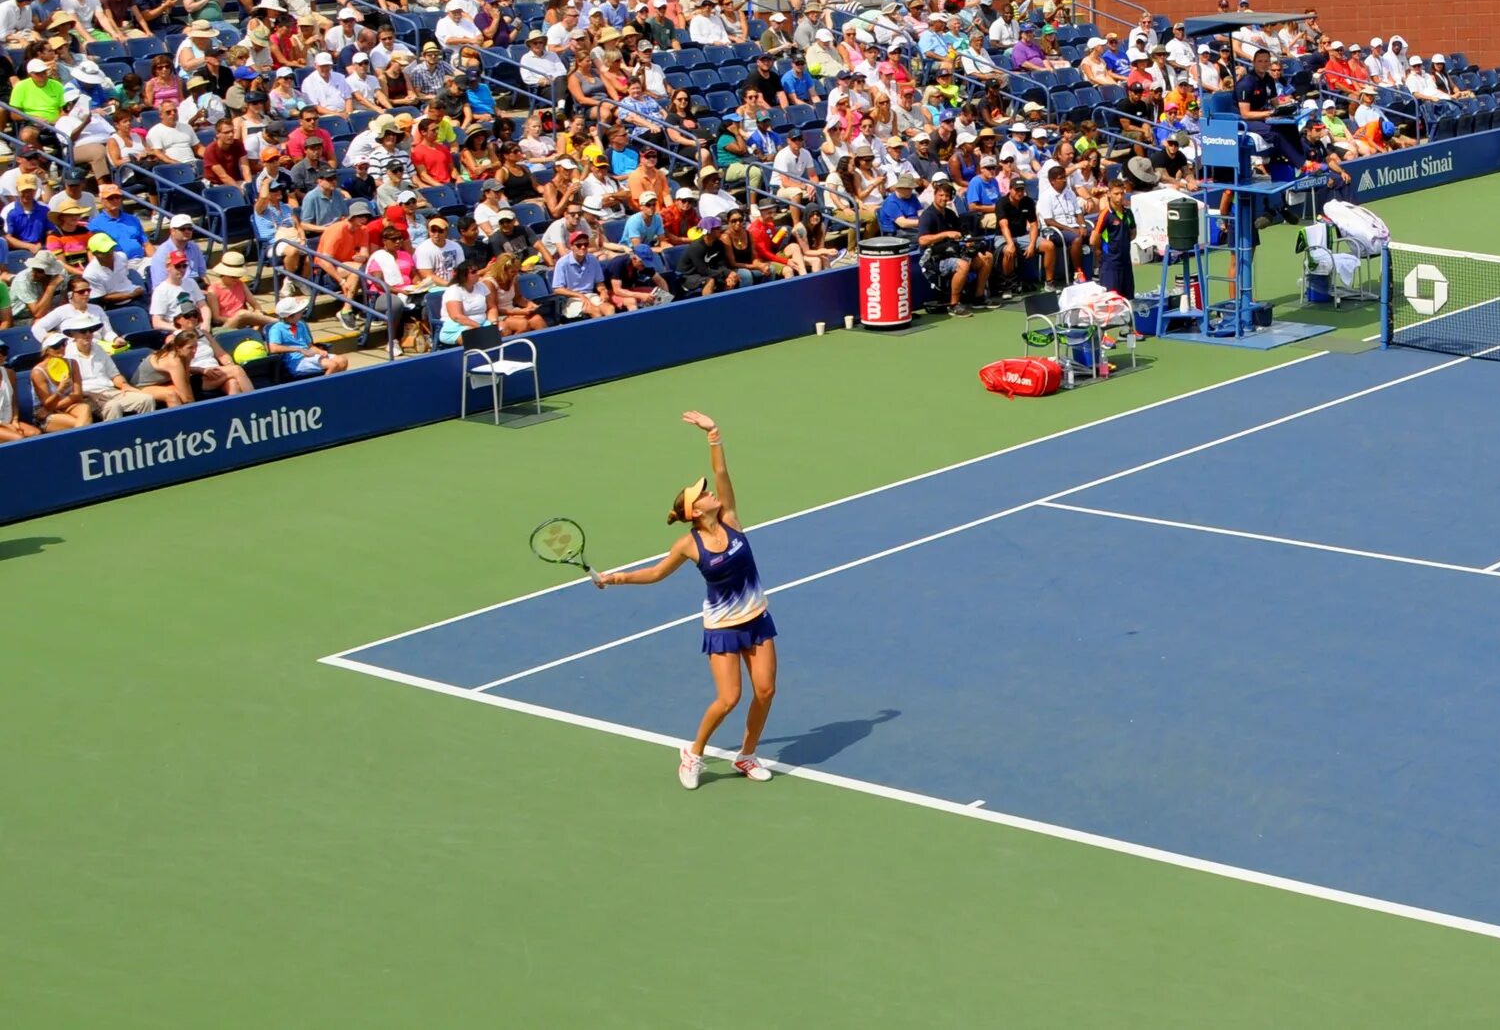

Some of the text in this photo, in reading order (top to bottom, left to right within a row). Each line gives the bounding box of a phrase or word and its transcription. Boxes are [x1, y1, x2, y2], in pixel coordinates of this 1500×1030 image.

[1202, 135, 1236, 146] Spectrum
[1377, 151, 1453, 187] Mount Sinai
[866, 259, 882, 321] Wilson
[897, 259, 909, 320] Wilson
[79, 406, 323, 481] Emirates Airline
